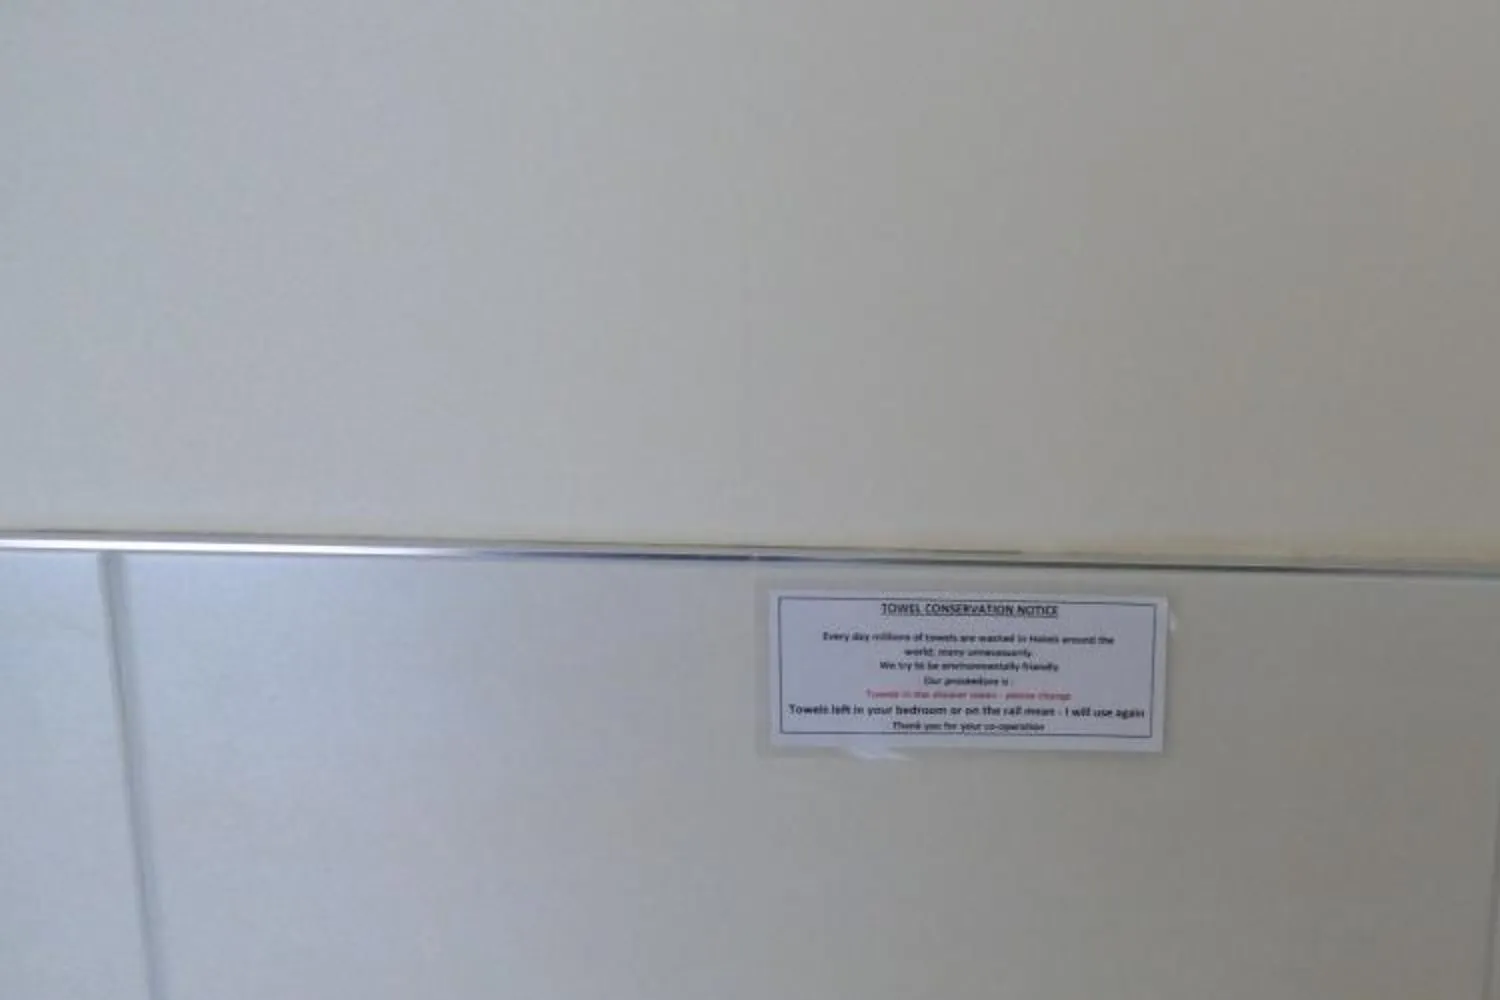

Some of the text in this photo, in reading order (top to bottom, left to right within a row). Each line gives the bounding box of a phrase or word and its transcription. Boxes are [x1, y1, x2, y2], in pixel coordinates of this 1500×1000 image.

[881, 602, 1059, 618] TOWEL CONSERVATION NOTICE
[823, 631, 849, 642] Every
[852, 631, 870, 642] day
[872, 632, 911, 642] millions
[913, 632, 924, 642] of
[925, 632, 957, 643] towels
[959, 634, 974, 643] are
[1017, 634, 1027, 644] in
[1062, 635, 1096, 645] around
[1098, 636, 1115, 646] the
[879, 660, 896, 670] We
[898, 661, 913, 672] try
[915, 661, 924, 670] to
[928, 661, 939, 670] be
[923, 676, 942, 686] Our
[788, 704, 829, 715] Towels
[831, 704, 851, 715] left
[854, 705, 864, 715] in
[867, 707, 893, 717] your
[895, 705, 947, 715] bedroom
[950, 707, 961, 715] or
[964, 707, 979, 716] on
[982, 705, 1001, 716] the
[1003, 706, 1022, 716] rail
[1071, 707, 1091, 718] will
[1093, 709, 1113, 718] use
[1115, 709, 1145, 719] again
[892, 721, 921, 730] Thank
[924, 723, 943, 732] you
[944, 721, 957, 731] for
[959, 723, 985, 734] your
